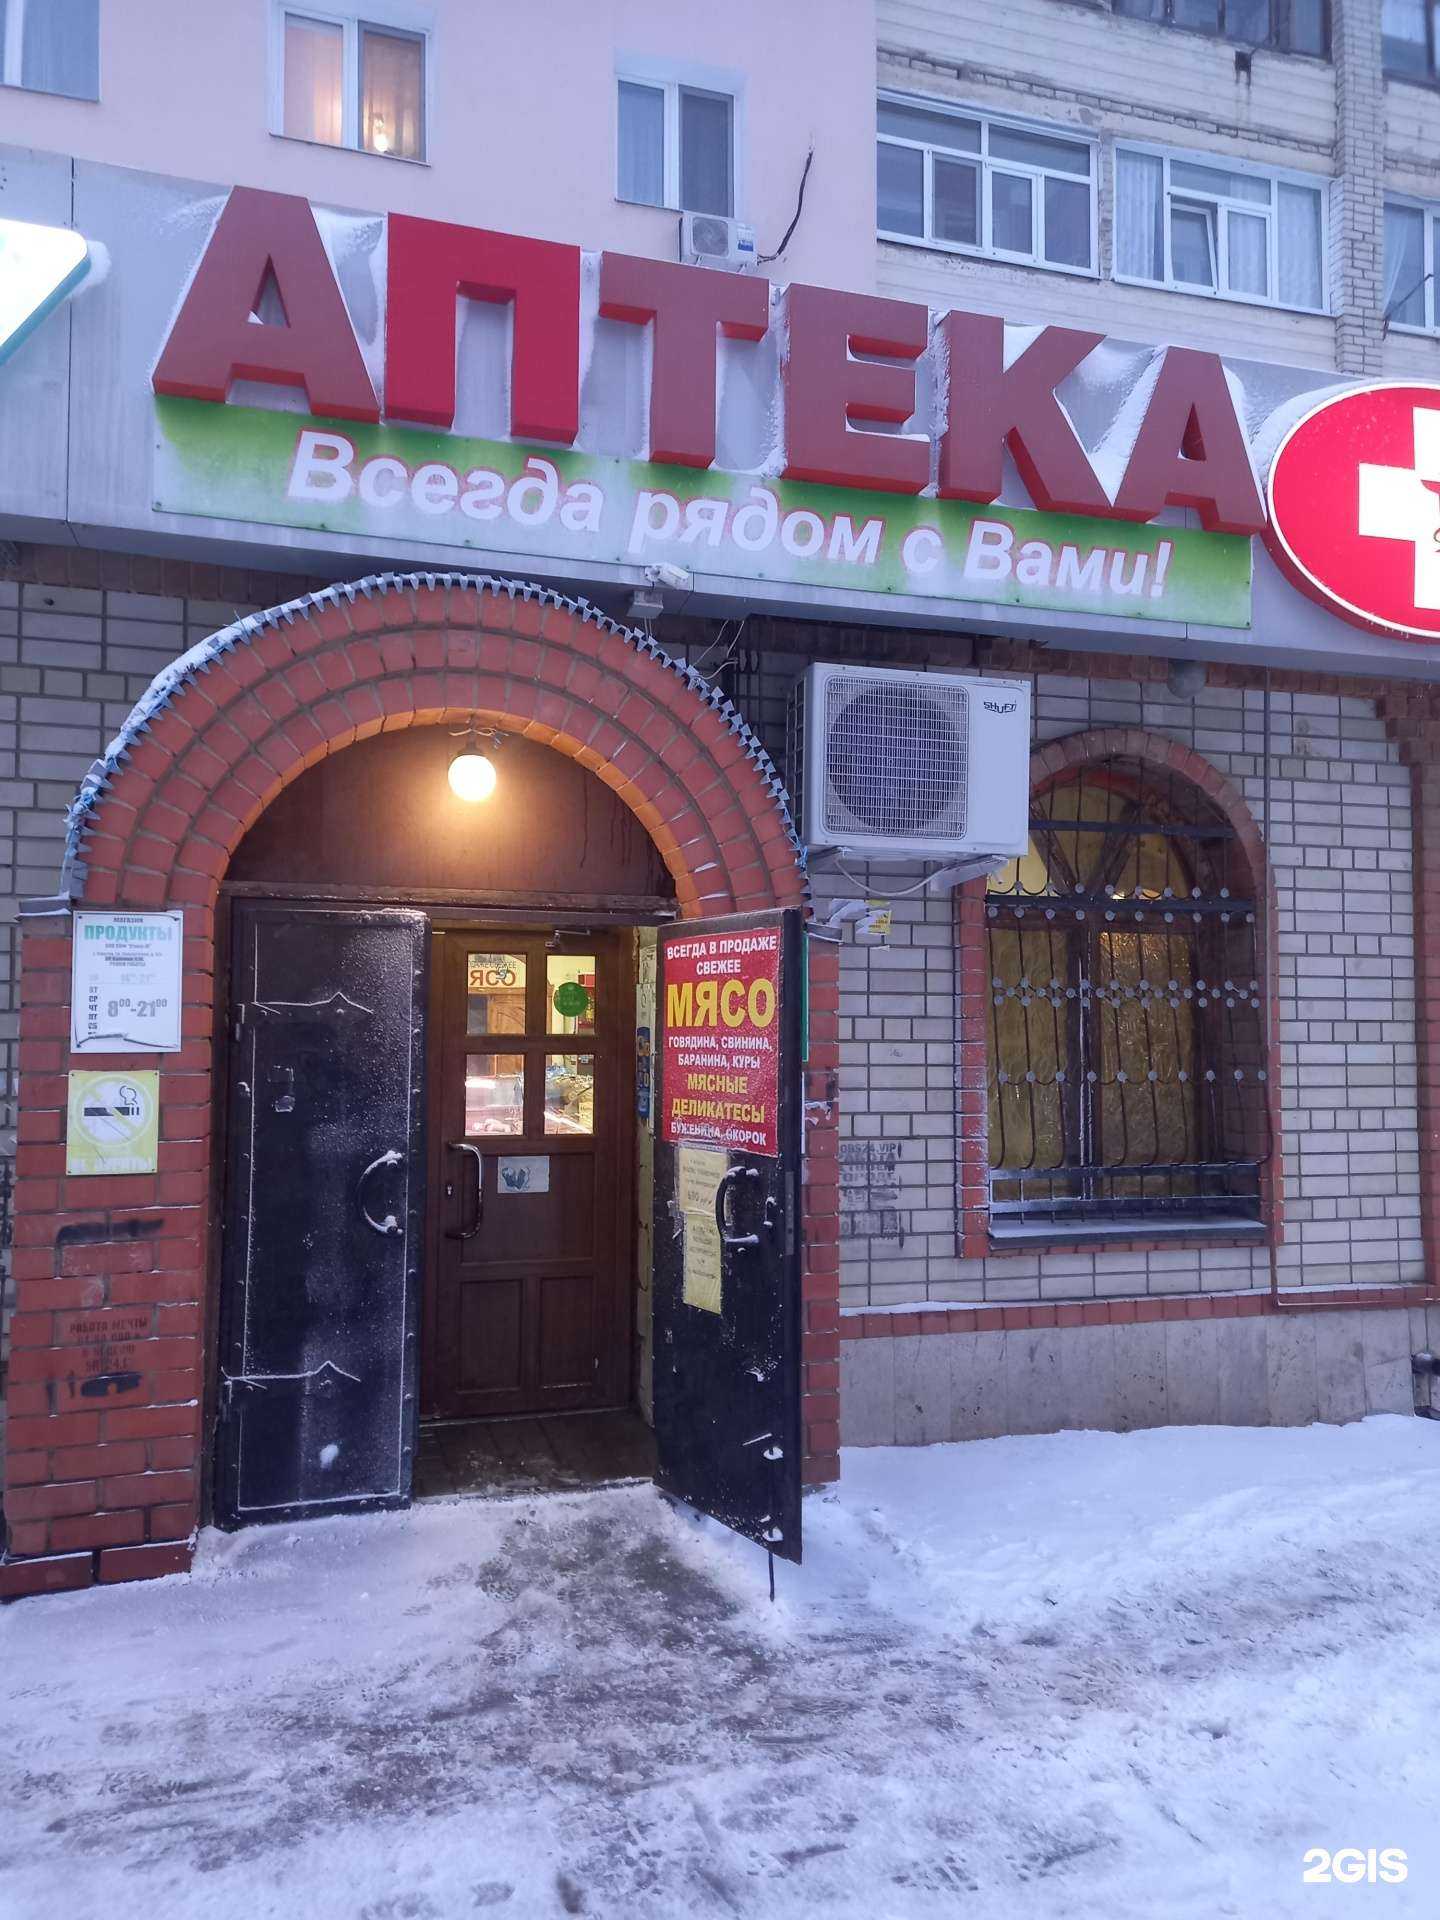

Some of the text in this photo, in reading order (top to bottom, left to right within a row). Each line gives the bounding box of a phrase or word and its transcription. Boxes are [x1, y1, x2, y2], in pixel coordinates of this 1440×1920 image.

[152, 186, 1268, 536] АПТЕКА
[287, 429, 1173, 599] Всегда рядом с Вами!
[84, 925, 172, 941] ПРОДУКТЫ
[667, 935, 777, 960] ВСЕГДА В ПРОДАЖЕ
[696, 959, 741, 976] СВЕЖЕЕ
[667, 978, 776, 1028] МЯСО
[668, 1036, 772, 1051] ГОВЯДИНА, СВИНИНА,
[678, 1053, 761, 1069] БАРАНИНА, КУРЫ
[687, 1074, 748, 1094] МЯСНЫЕ
[672, 1098, 765, 1123] ДЕЛИКАТЕСЫ
[726, 1129, 767, 1146] ОКОРОК
